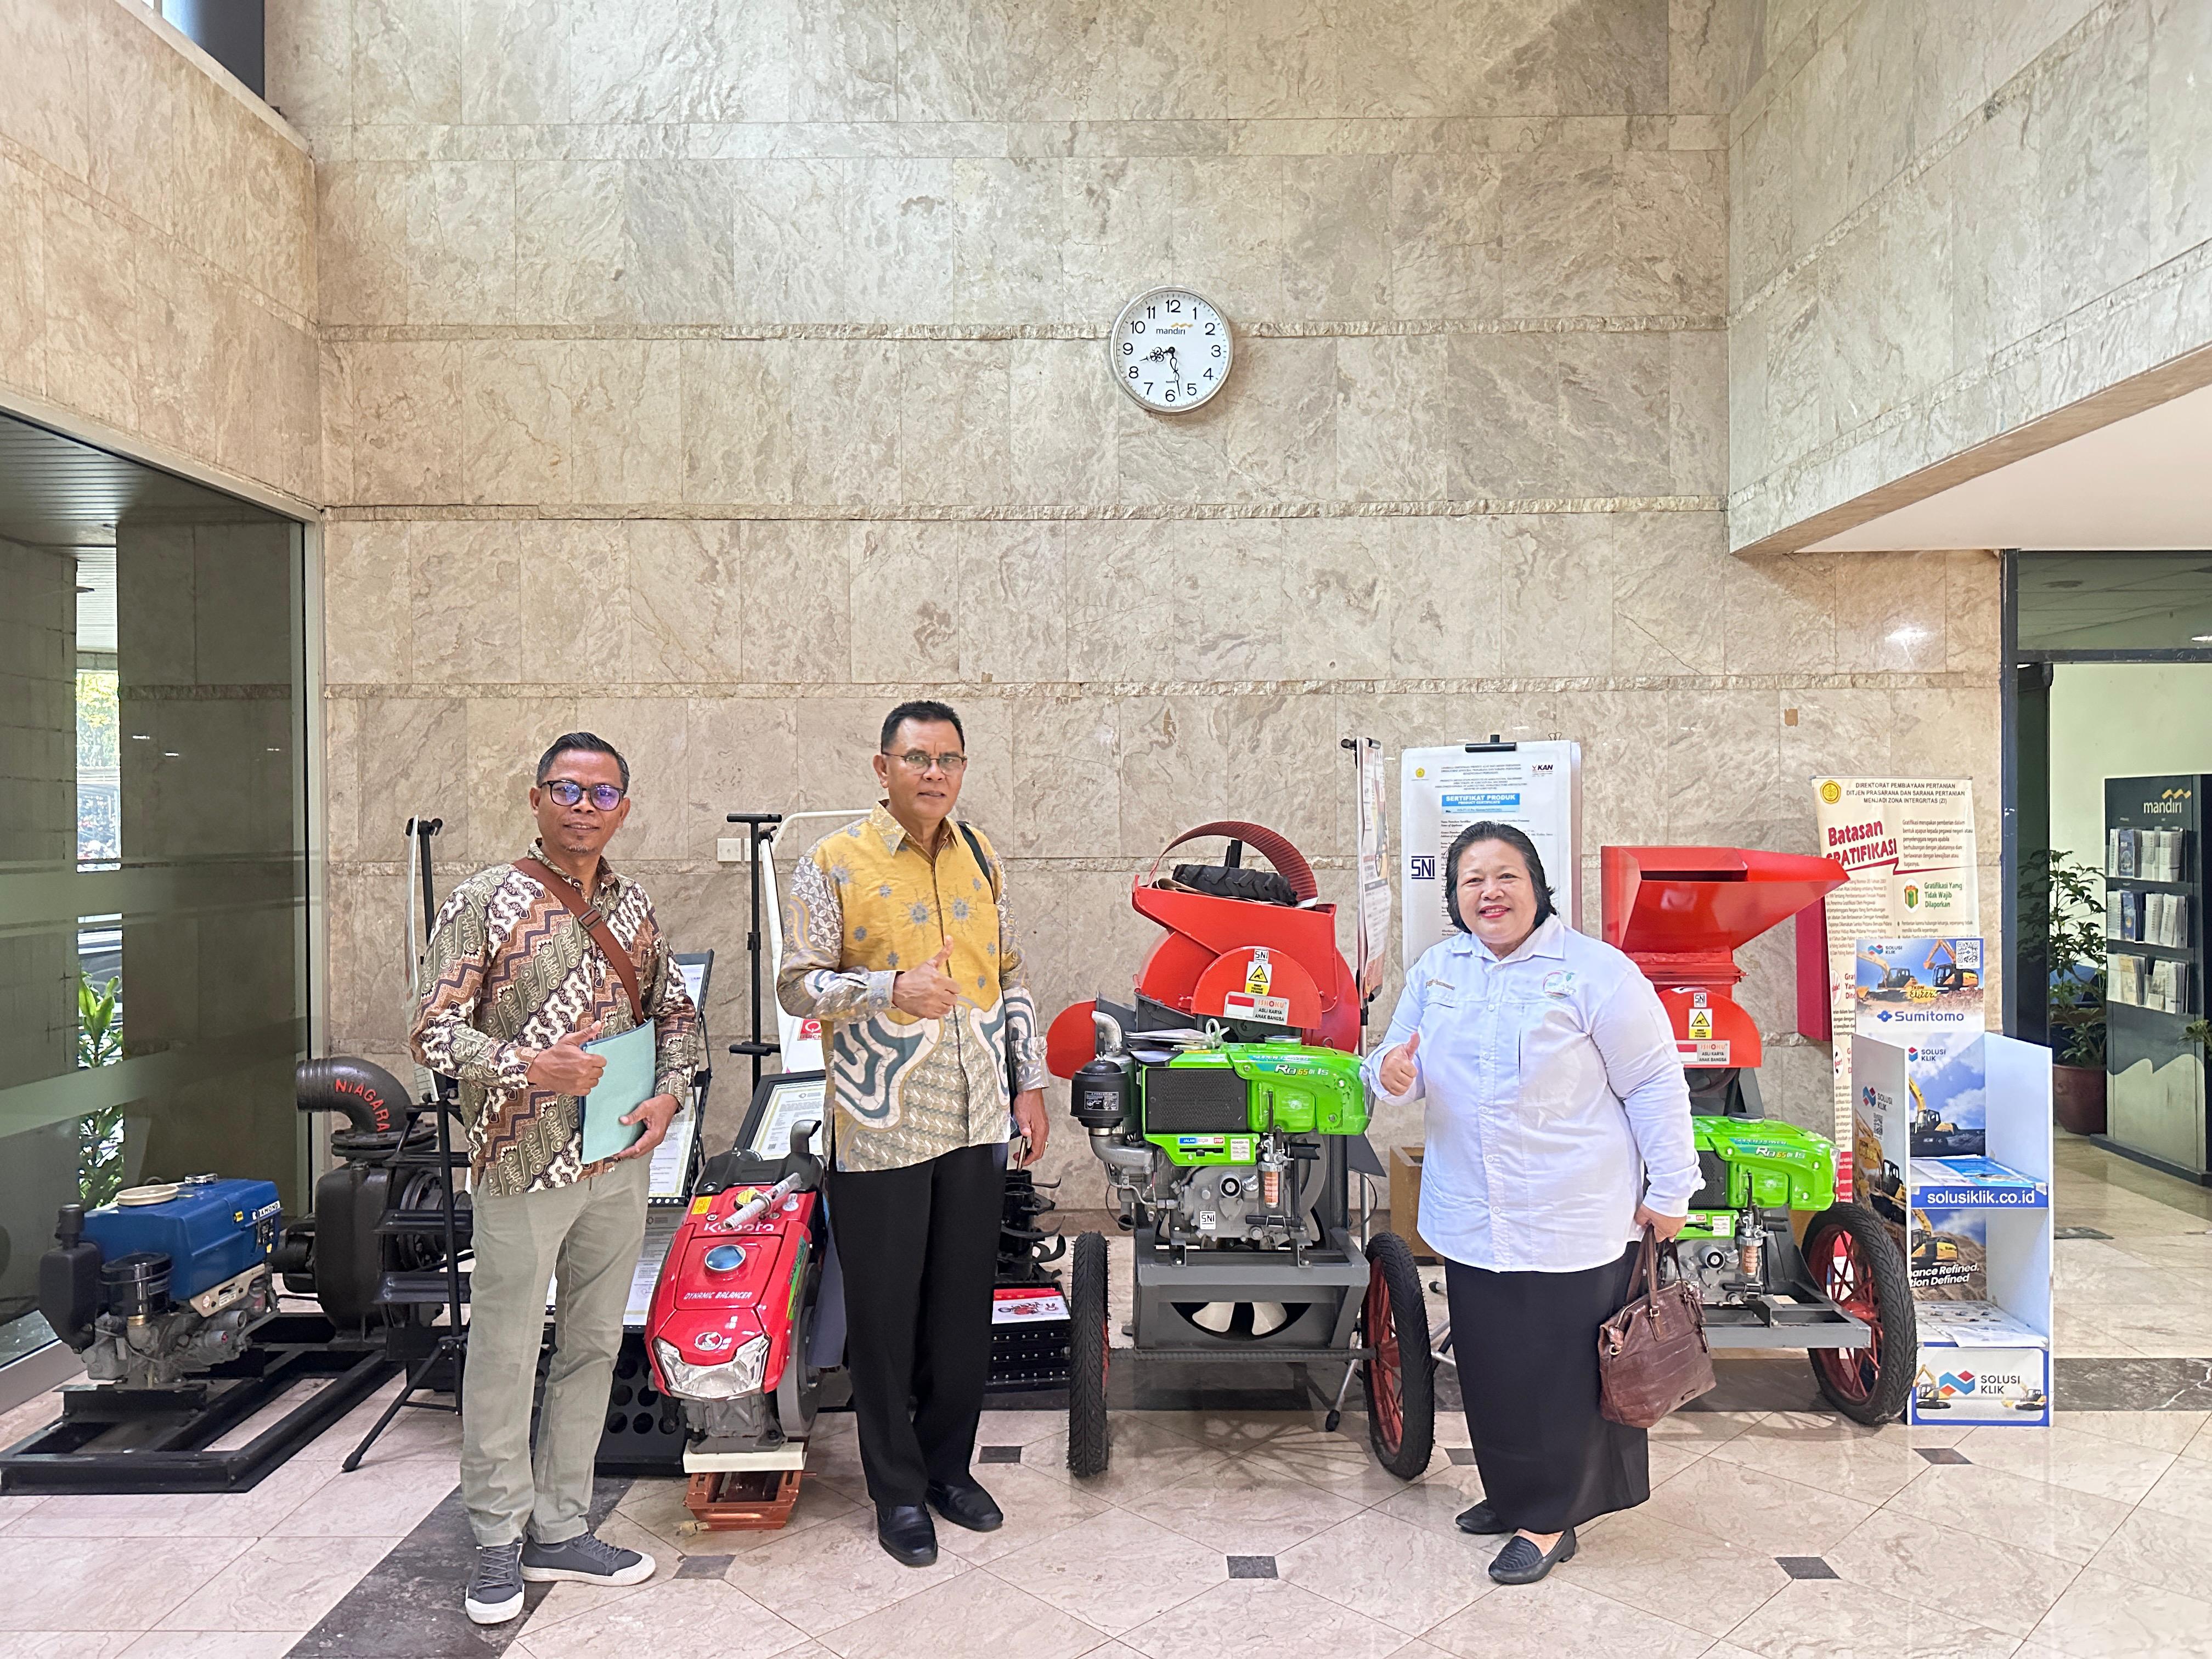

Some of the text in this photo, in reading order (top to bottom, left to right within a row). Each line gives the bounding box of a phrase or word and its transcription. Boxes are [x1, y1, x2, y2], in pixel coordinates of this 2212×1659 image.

[1147, 306, 1155, 319] 11
[1166, 300, 1181, 313] 12
[1193, 307, 1197, 320] 1
[1131, 320, 1146, 334] 10
[1205, 323, 1215, 335] 2
[1122, 343, 1133, 355] 9
[1211, 345, 1221, 357] 3
[1128, 366, 1138, 379] 8
[1203, 368, 1214, 380] 4
[1144, 382, 1153, 395] 7
[1187, 383, 1197, 396] 5
[1166, 390, 1175, 402] 6
[2143, 798, 2182, 814] mandiri
[1828, 820, 1883, 847] Batasan
[1411, 859, 1435, 877] SNI
[1949, 882, 1962, 890] Yang
[1938, 891, 1952, 900] Wajib
[1925, 901, 1950, 910] Dilaporkan
[1695, 994, 1705, 1003] SNI
[1910, 989, 1938, 998] 31,77%
[1258, 1000, 1284, 1008] ISHOKU
[1895, 1011, 1964, 1022] Sumitomo
[336, 1078, 391, 1131] NIAGARA
[1877, 1092, 1893, 1106] SOLUSI
[1877, 1101, 1887, 1111] KLIK
[1927, 1190, 2035, 1204] solusiklik.co.id
[1939, 1263, 1979, 1274] Refined.
[1931, 1273, 1970, 1285] Defined
[715, 1291, 753, 1300] BALANCER
[1980, 1375, 2021, 1384] SOLUSI
[1980, 1385, 2004, 1394] KLIK
